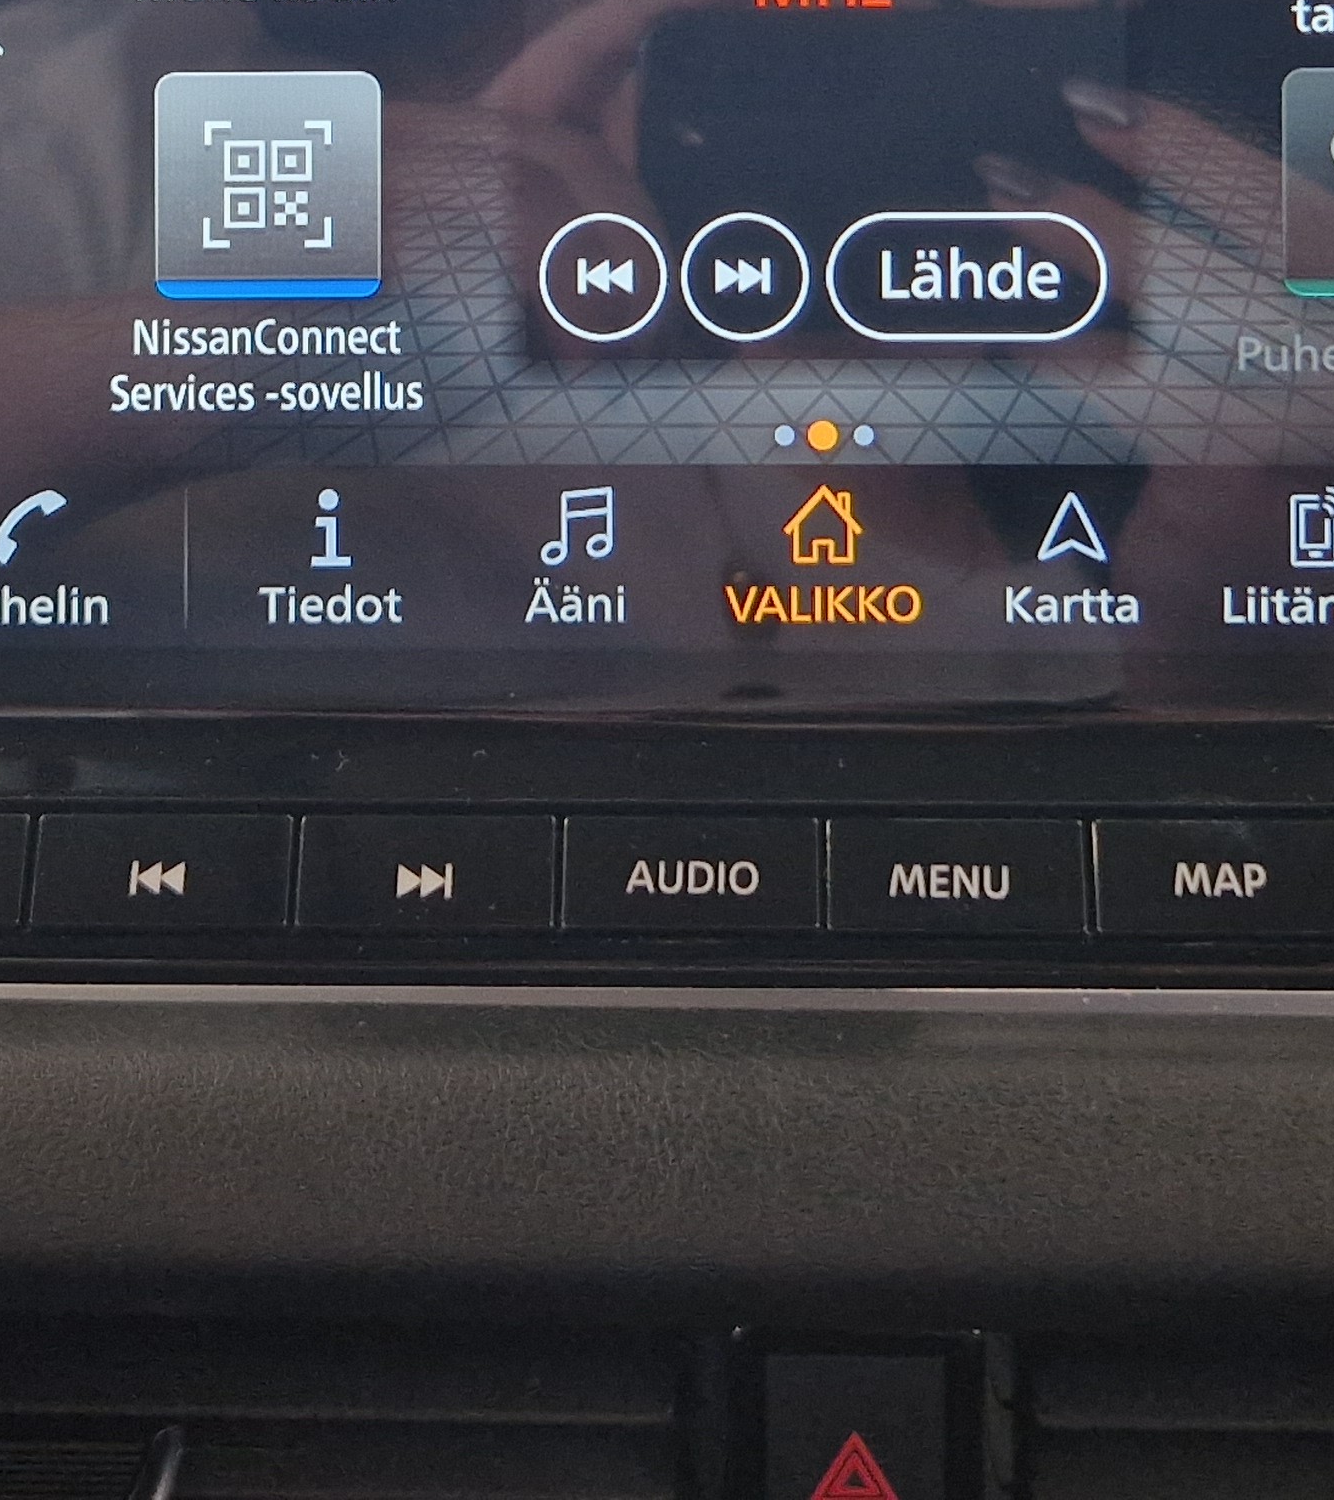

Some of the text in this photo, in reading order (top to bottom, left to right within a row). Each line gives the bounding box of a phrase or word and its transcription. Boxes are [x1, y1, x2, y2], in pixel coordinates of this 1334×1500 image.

[879, 243, 1061, 301] Lähde
[132, 317, 402, 357] NissanConnect
[109, 371, 425, 413] Services -sovellus
[258, 585, 403, 624] Tiedot
[524, 577, 627, 624] Ääni
[724, 585, 923, 624] VALIKKO
[1003, 585, 1141, 625] Kartta
[625, 859, 760, 897] AUDIO
[888, 862, 1011, 900] MENU
[1172, 862, 1268, 899] MAP
